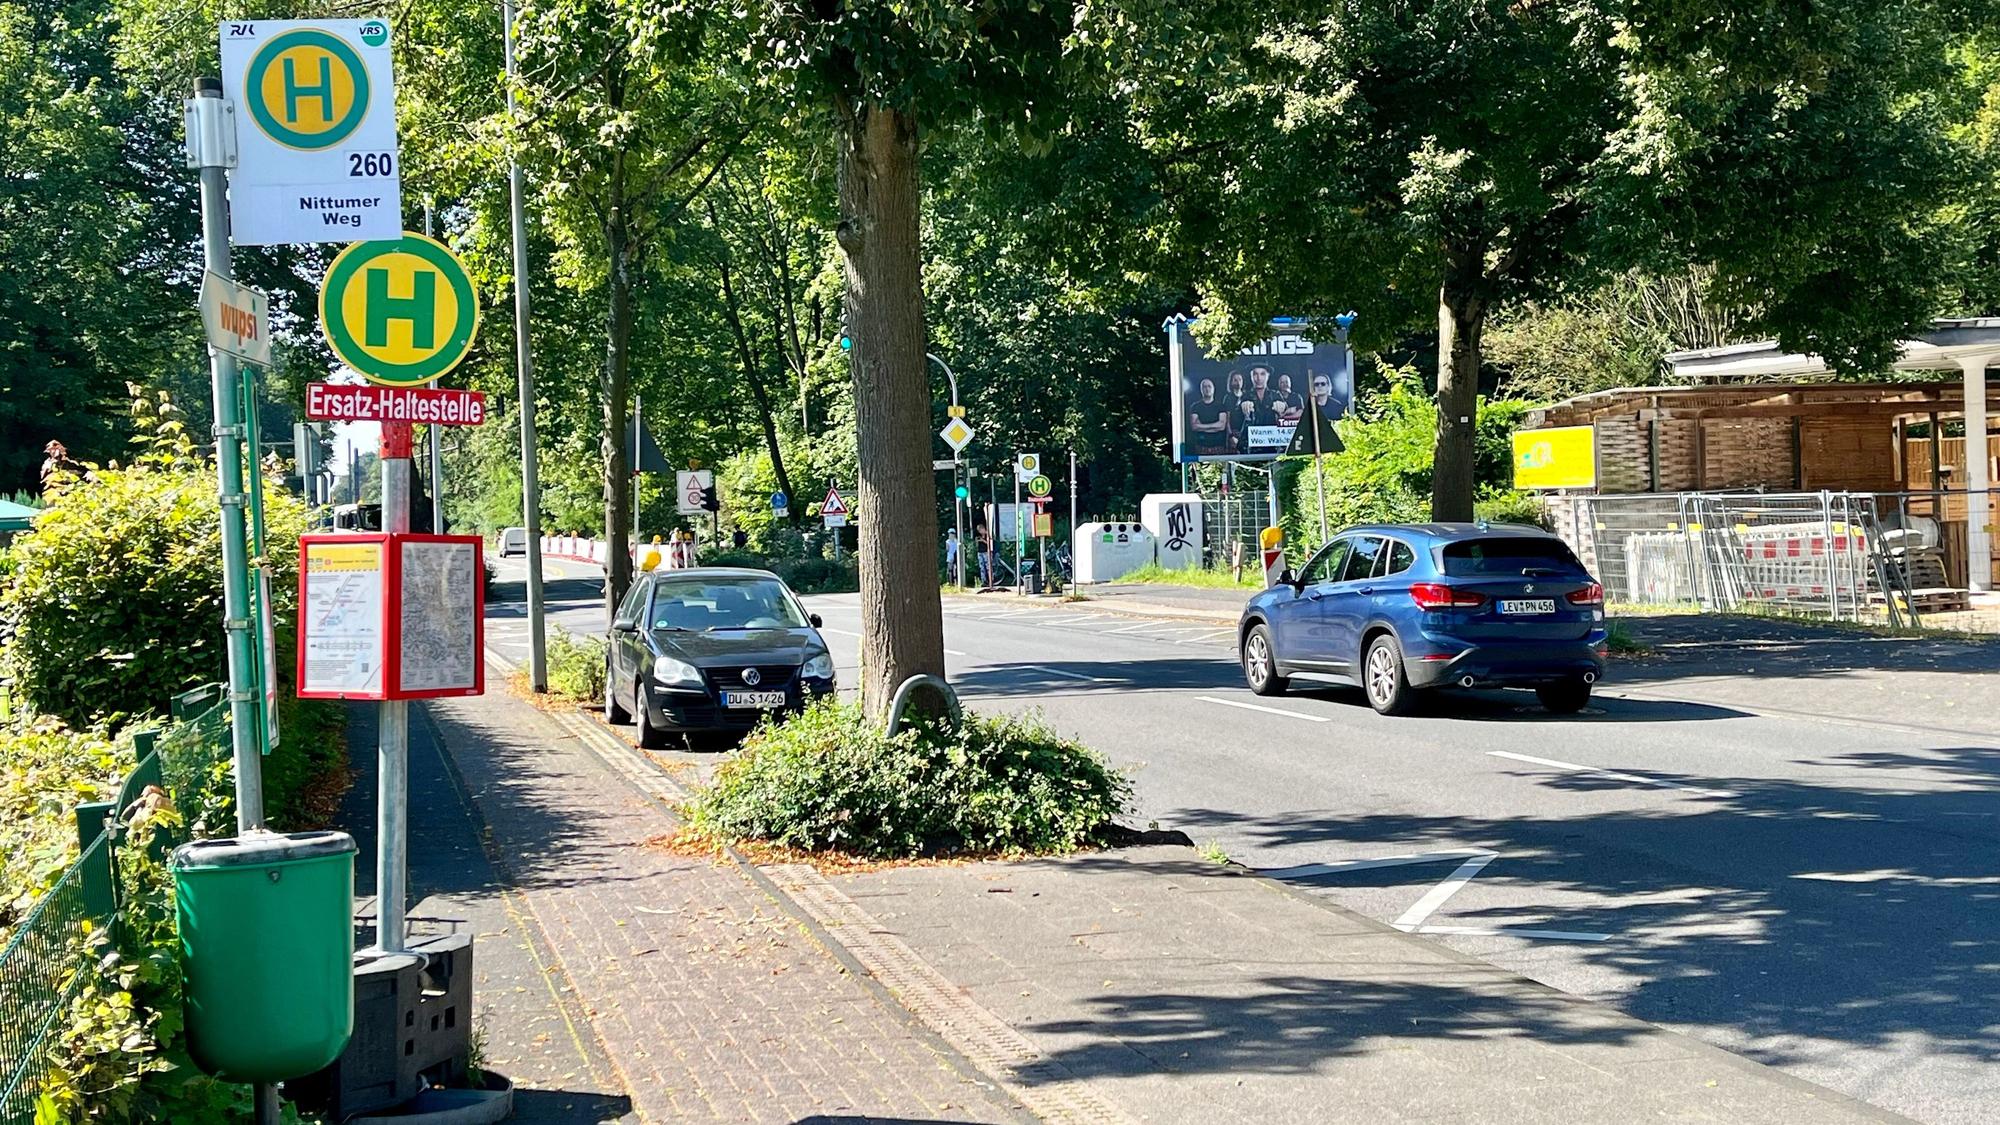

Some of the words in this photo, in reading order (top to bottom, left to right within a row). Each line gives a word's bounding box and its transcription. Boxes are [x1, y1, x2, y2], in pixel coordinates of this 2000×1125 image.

[359, 26, 380, 35] VRS
[283, 57, 333, 123] H
[349, 153, 392, 177] 260
[299, 196, 381, 210] Nittumer
[322, 212, 362, 227] Weg
[365, 268, 436, 350] H
[220, 297, 258, 347] wupsi
[309, 386, 481, 423] Ersatz-Haltestelle
[1250, 428, 1273, 436] Wann:
[1250, 437, 1265, 445] Wo:
[1035, 480, 1045, 491] H
[1502, 601, 1519, 612] LEV
[1525, 601, 1537, 611] PN
[1538, 601, 1554, 612] 456
[728, 694, 742, 704] DU
[749, 694, 756, 704] S
